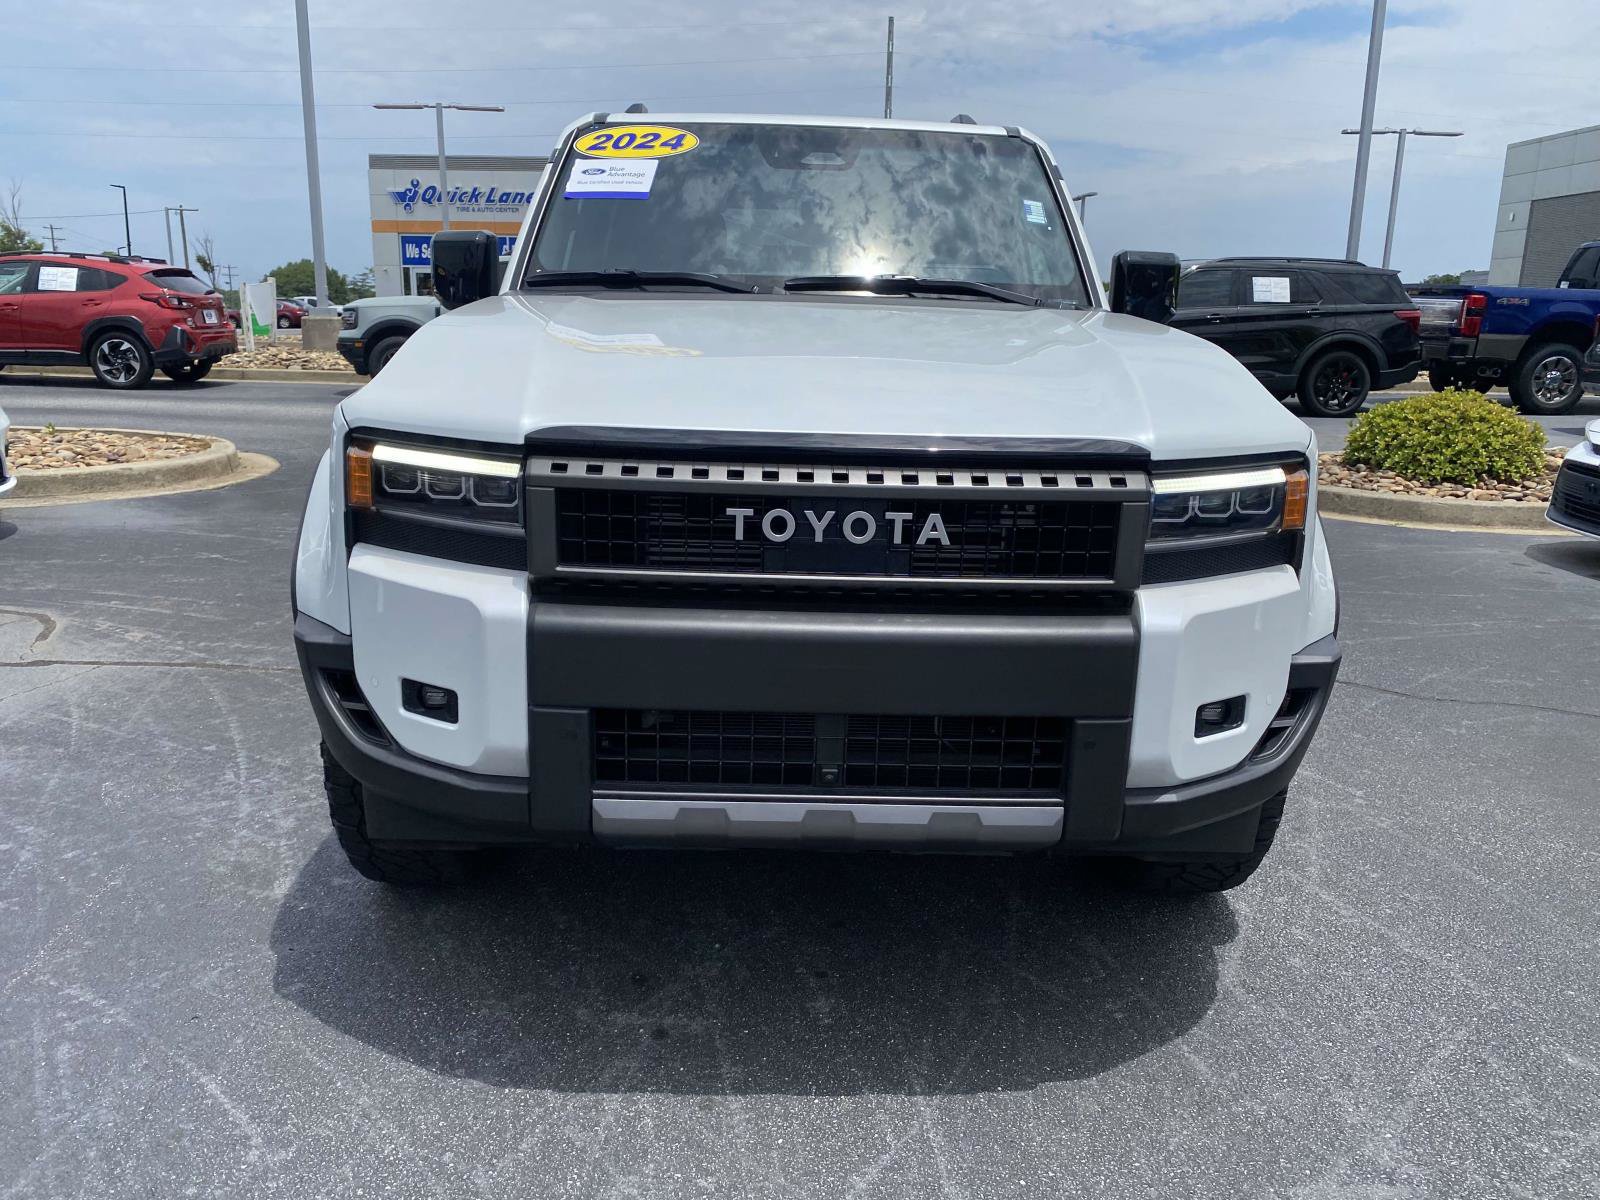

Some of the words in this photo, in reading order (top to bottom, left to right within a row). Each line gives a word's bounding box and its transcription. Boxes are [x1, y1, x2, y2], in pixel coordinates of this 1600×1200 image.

[586, 132, 687, 151] 2024
[406, 243, 420, 258] We
[725, 507, 951, 545] TOYOTA
